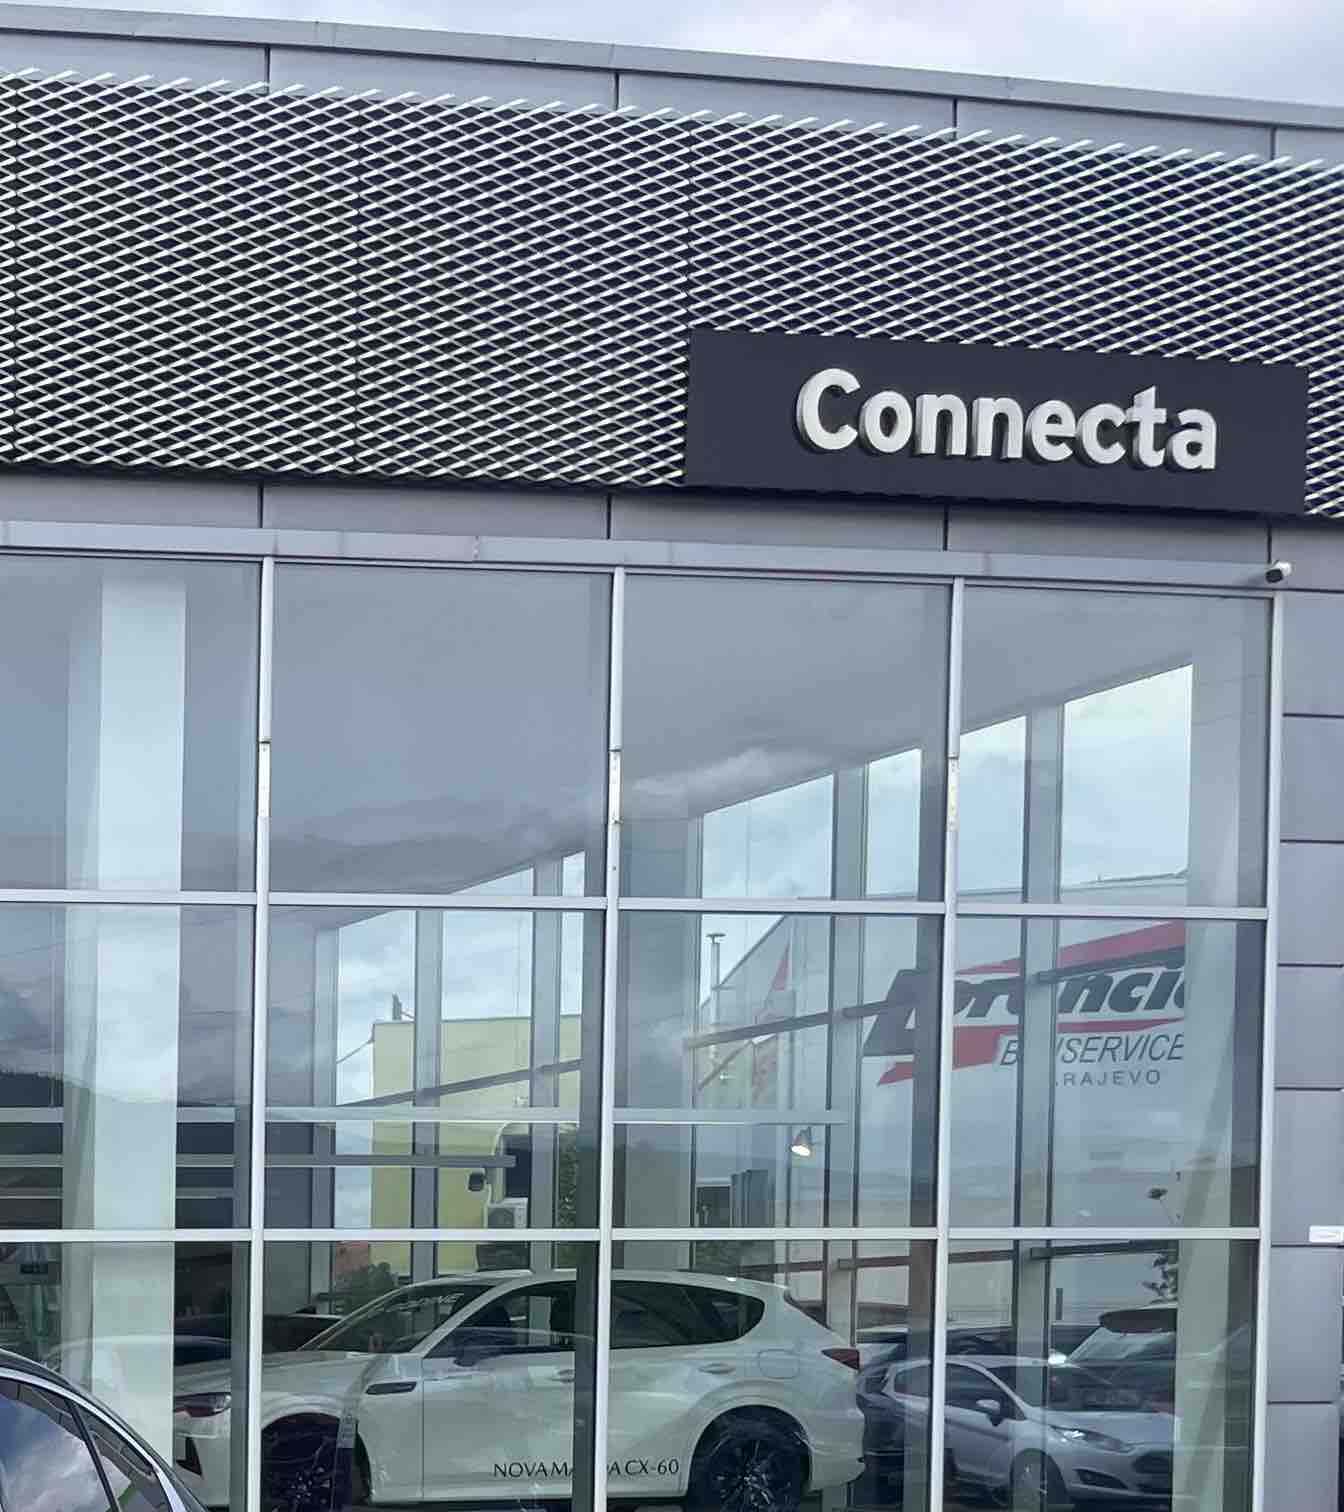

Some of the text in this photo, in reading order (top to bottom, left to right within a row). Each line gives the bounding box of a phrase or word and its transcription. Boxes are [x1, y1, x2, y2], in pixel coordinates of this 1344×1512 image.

[795, 367, 1217, 471] Connecta
[493, 1461, 548, 1478] NOVA
[625, 1457, 680, 1476] CX-60
